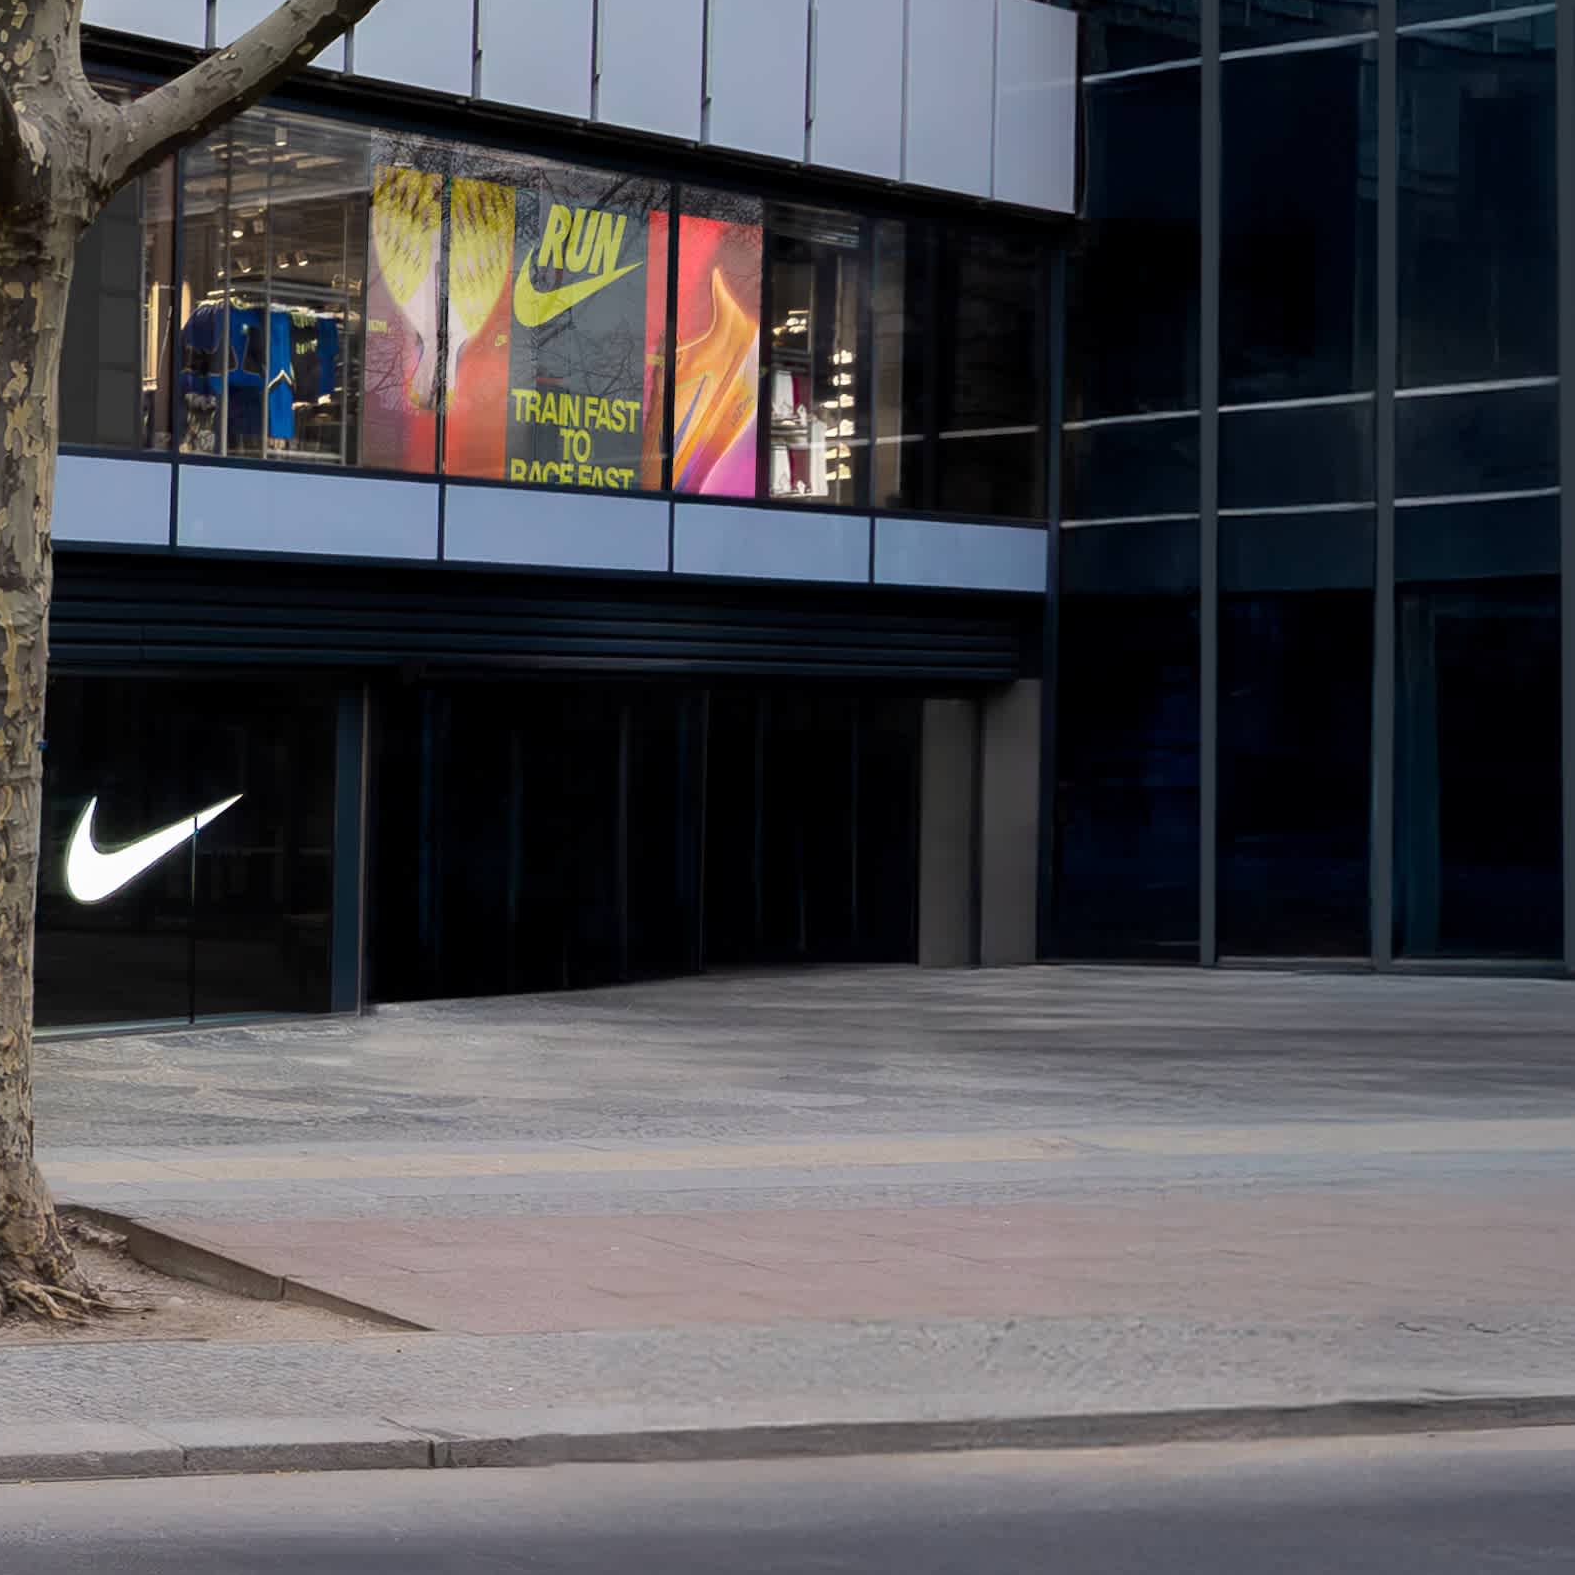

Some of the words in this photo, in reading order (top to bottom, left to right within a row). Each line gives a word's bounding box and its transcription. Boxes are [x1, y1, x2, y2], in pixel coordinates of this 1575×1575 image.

[537, 203, 628, 275] RUN
[510, 388, 581, 427] TRAIN
[584, 396, 641, 433] FAST
[559, 428, 592, 463] TO
[510, 458, 575, 485] RACE
[578, 464, 635, 491] FAST
